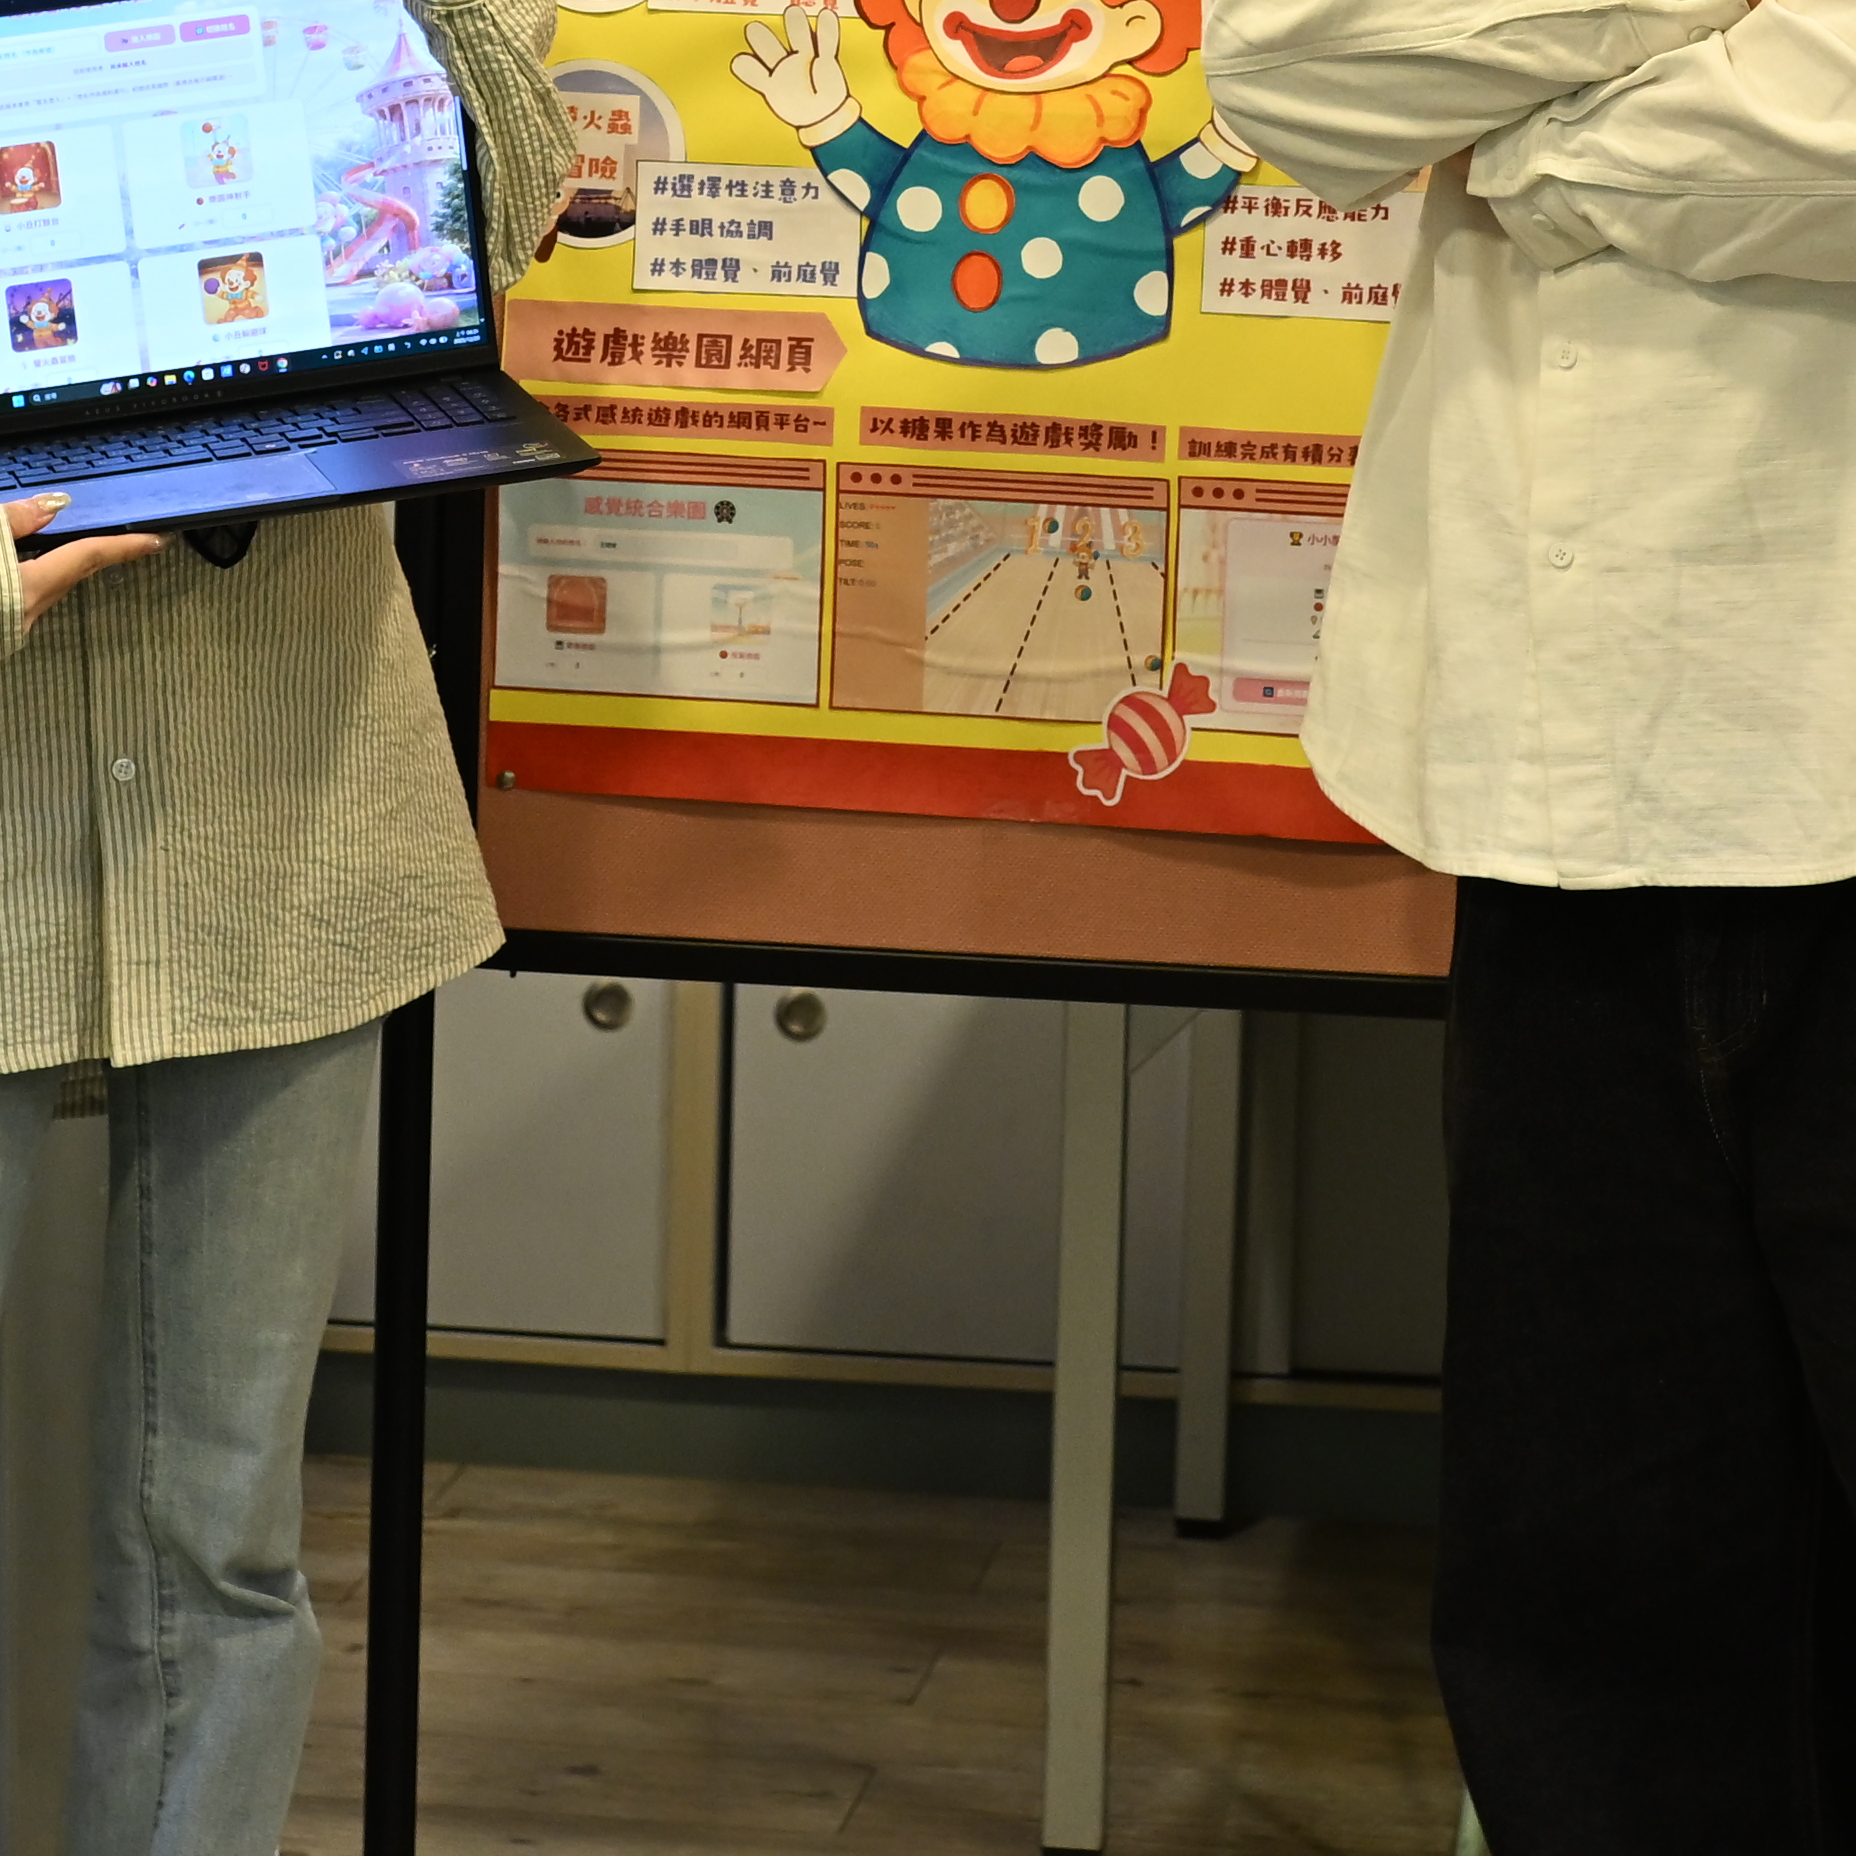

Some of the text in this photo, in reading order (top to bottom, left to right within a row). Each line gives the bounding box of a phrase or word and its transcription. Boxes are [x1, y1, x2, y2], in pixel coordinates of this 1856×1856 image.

[652, 174, 821, 205] #選擇性注意力
[651, 216, 774, 242] #手眼協調
[1220, 235, 1344, 263] #重心轉移
[649, 256, 842, 288] #本體覺、前庭覺
[552, 326, 815, 374] 遊戲樂園網頁
[584, 496, 708, 521] 感覺統合樂園
[1121, 520, 1143, 559] 3
